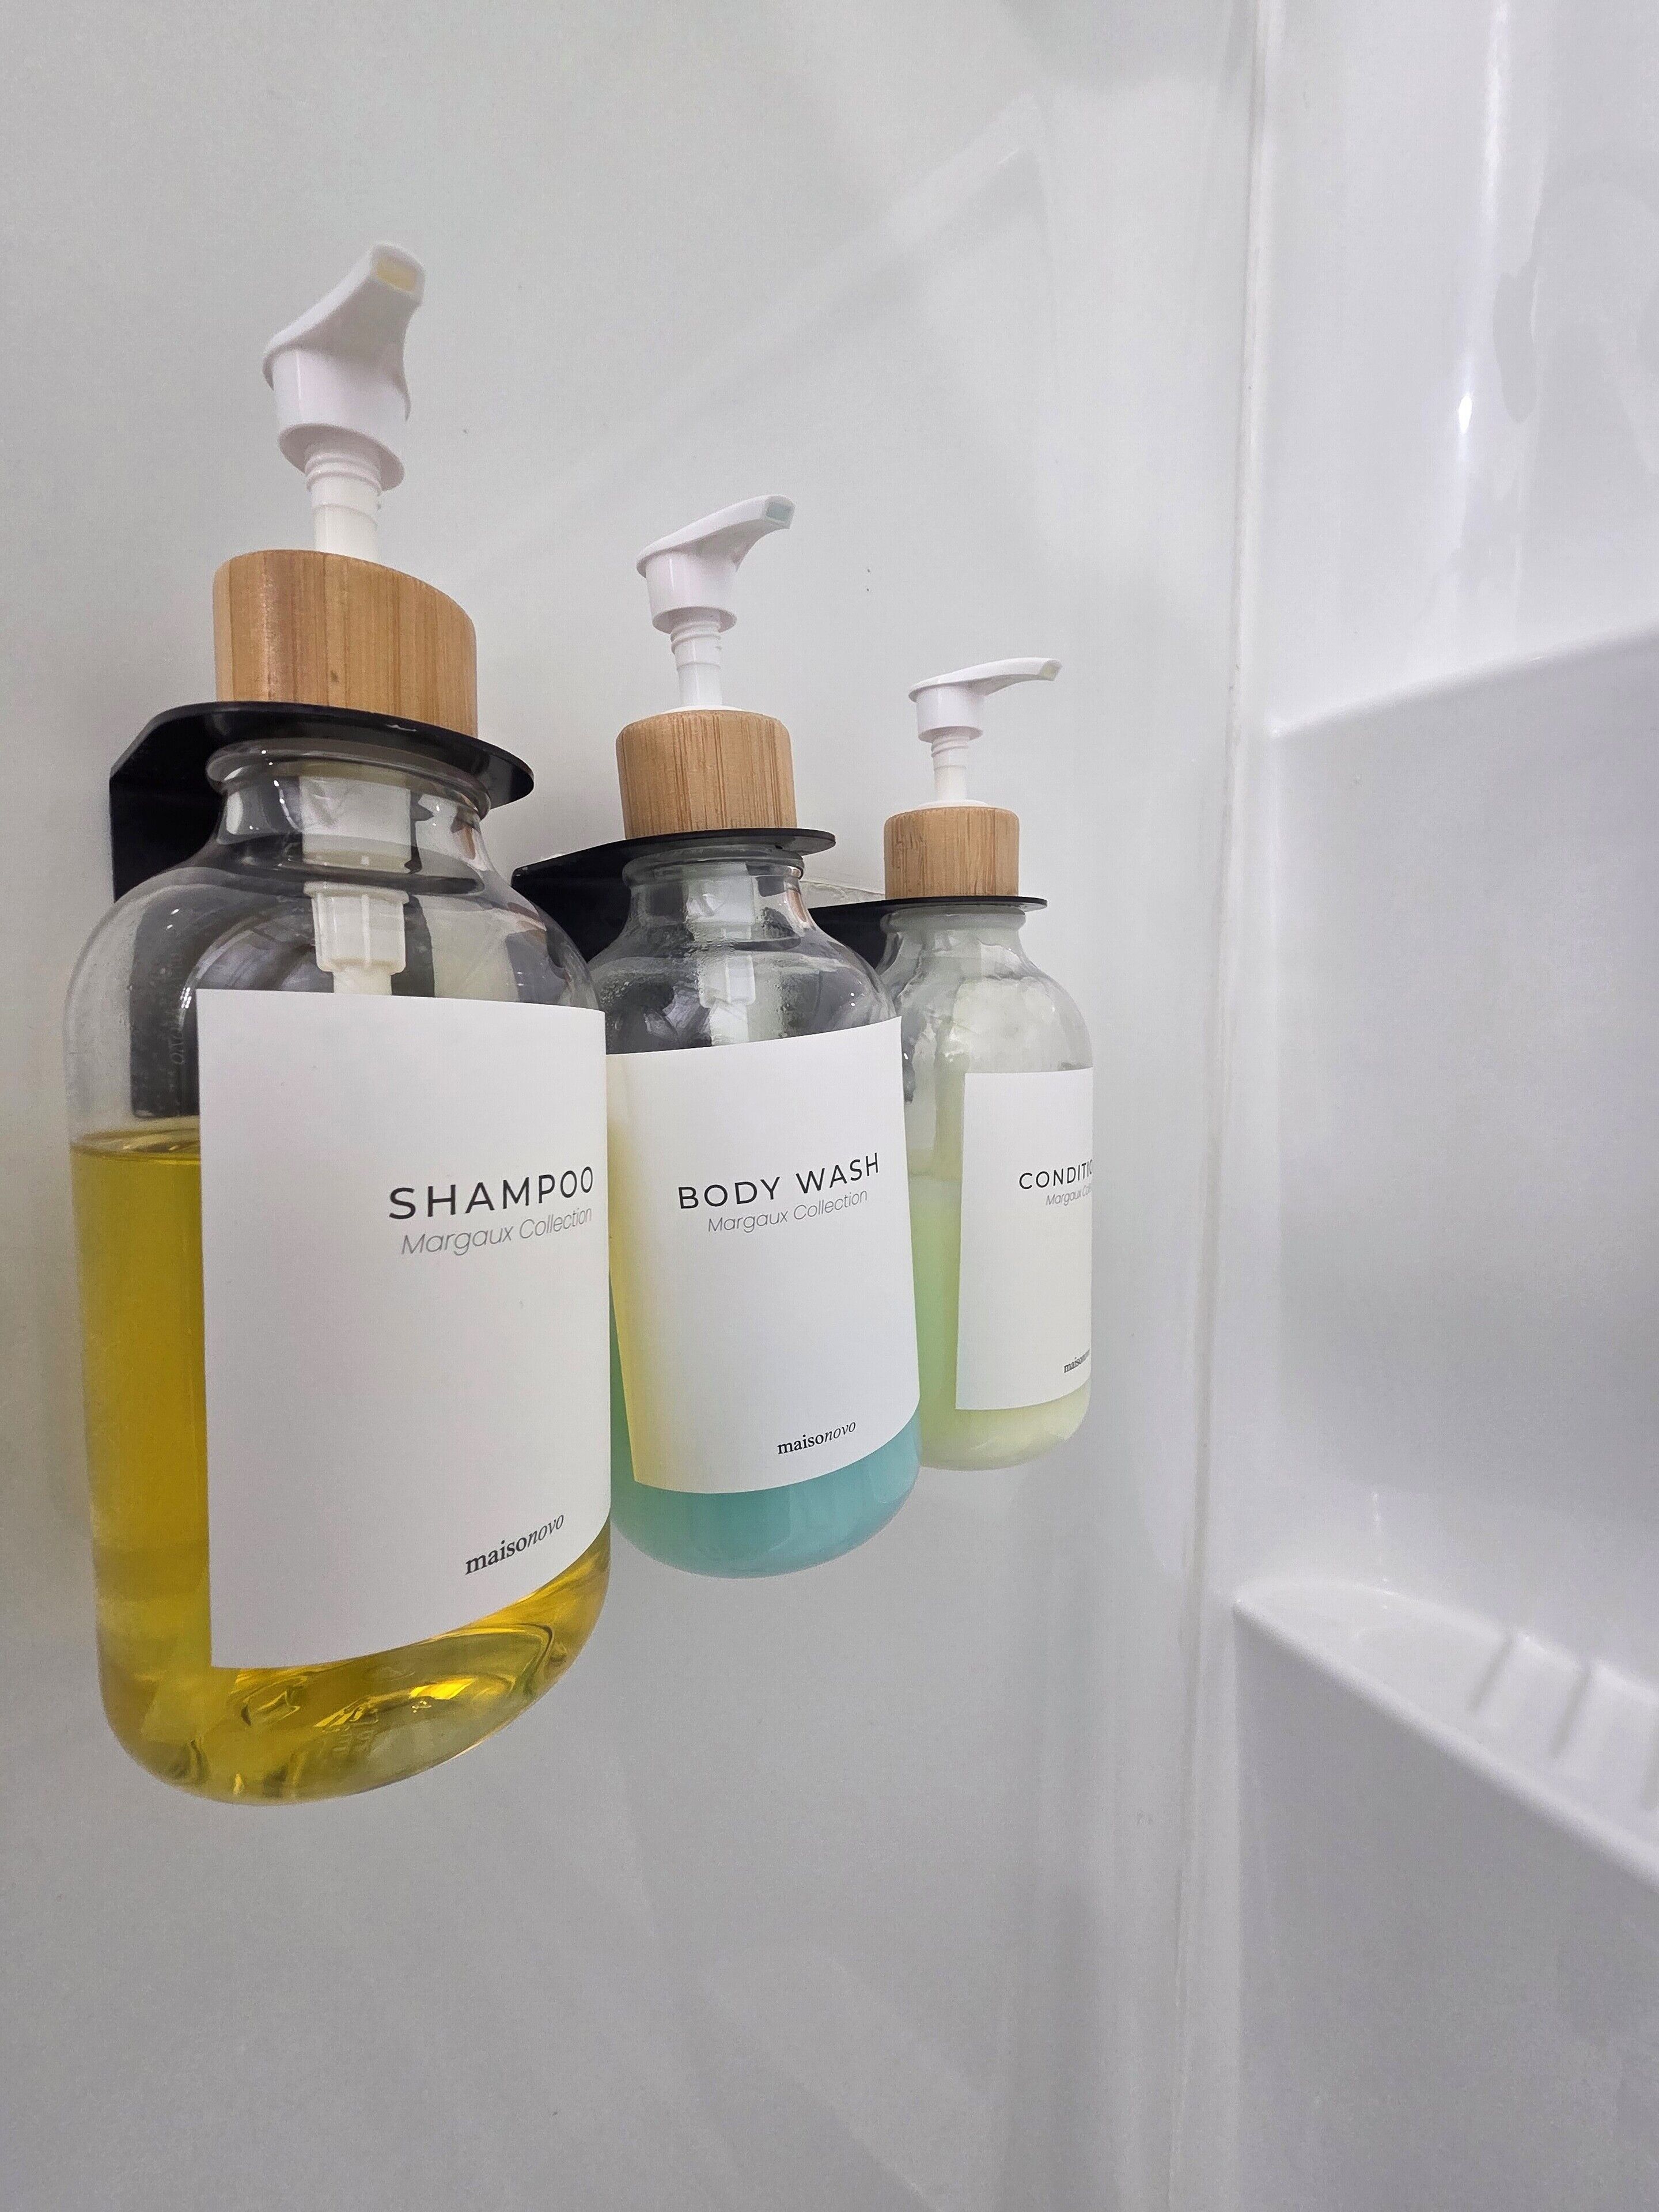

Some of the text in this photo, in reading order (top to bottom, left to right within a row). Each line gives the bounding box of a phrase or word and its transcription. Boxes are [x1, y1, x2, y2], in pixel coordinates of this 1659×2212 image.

[389, 1166, 593, 1219] SHAMPOO
[678, 1152, 878, 1209] BODY WASH
[401, 1207, 592, 1256] Margaux Collection
[708, 1190, 868, 1233] Margaux Collection
[777, 1422, 856, 1455] maisonovo
[465, 1514, 564, 1575] maisonovo
